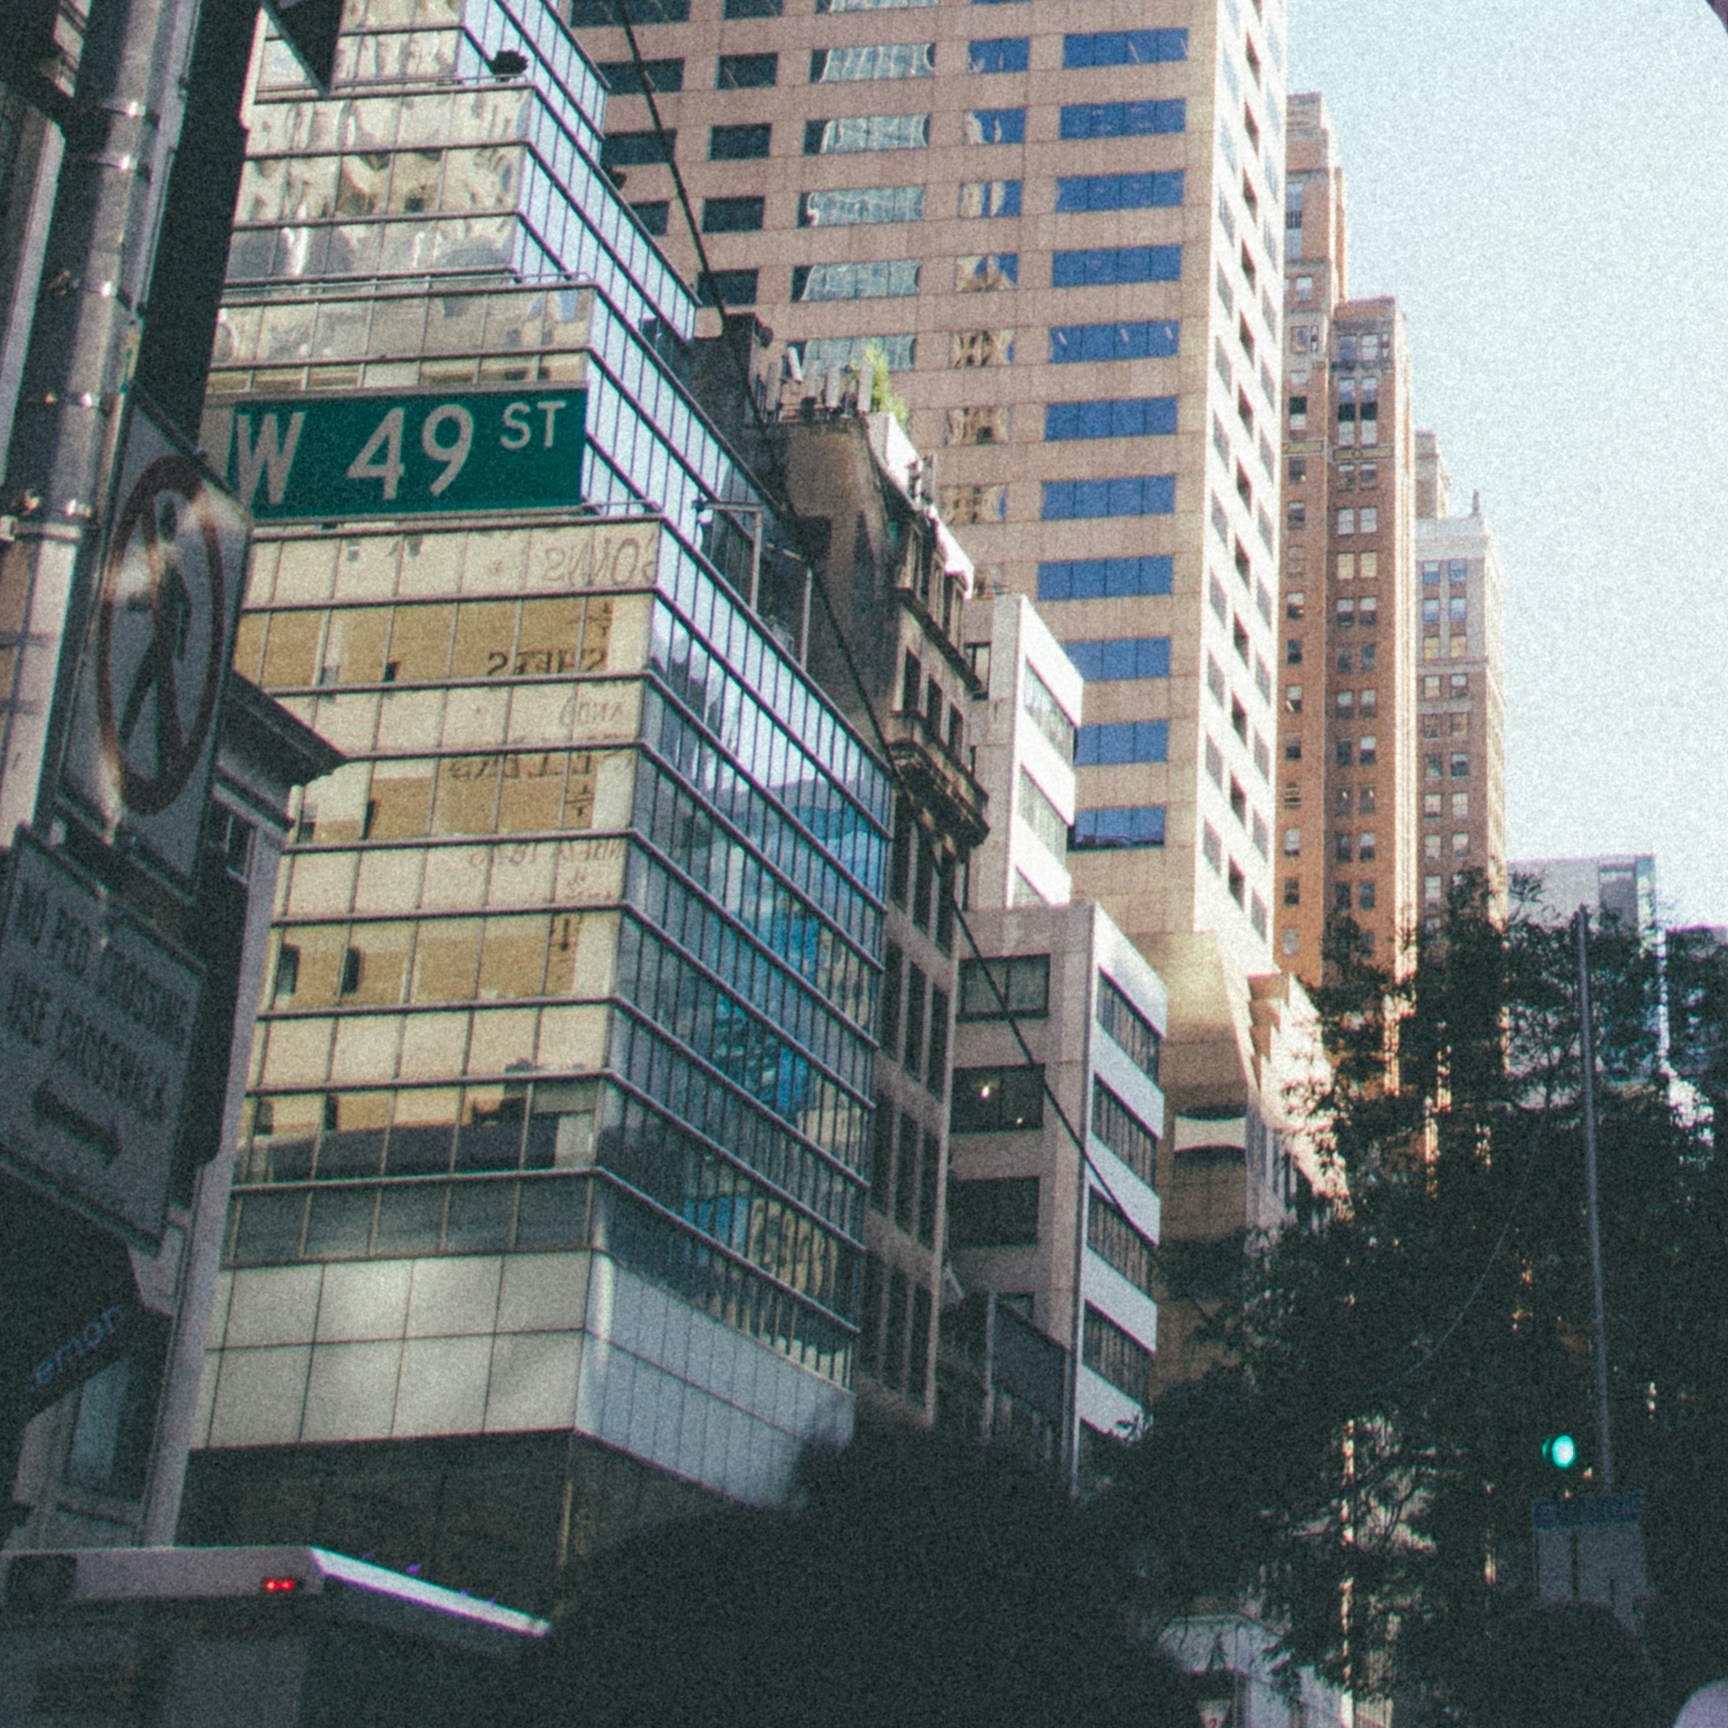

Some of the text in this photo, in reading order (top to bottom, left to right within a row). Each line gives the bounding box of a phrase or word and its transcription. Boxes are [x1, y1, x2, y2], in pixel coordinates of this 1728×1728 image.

[234, 400, 566, 506] W 49 ST
